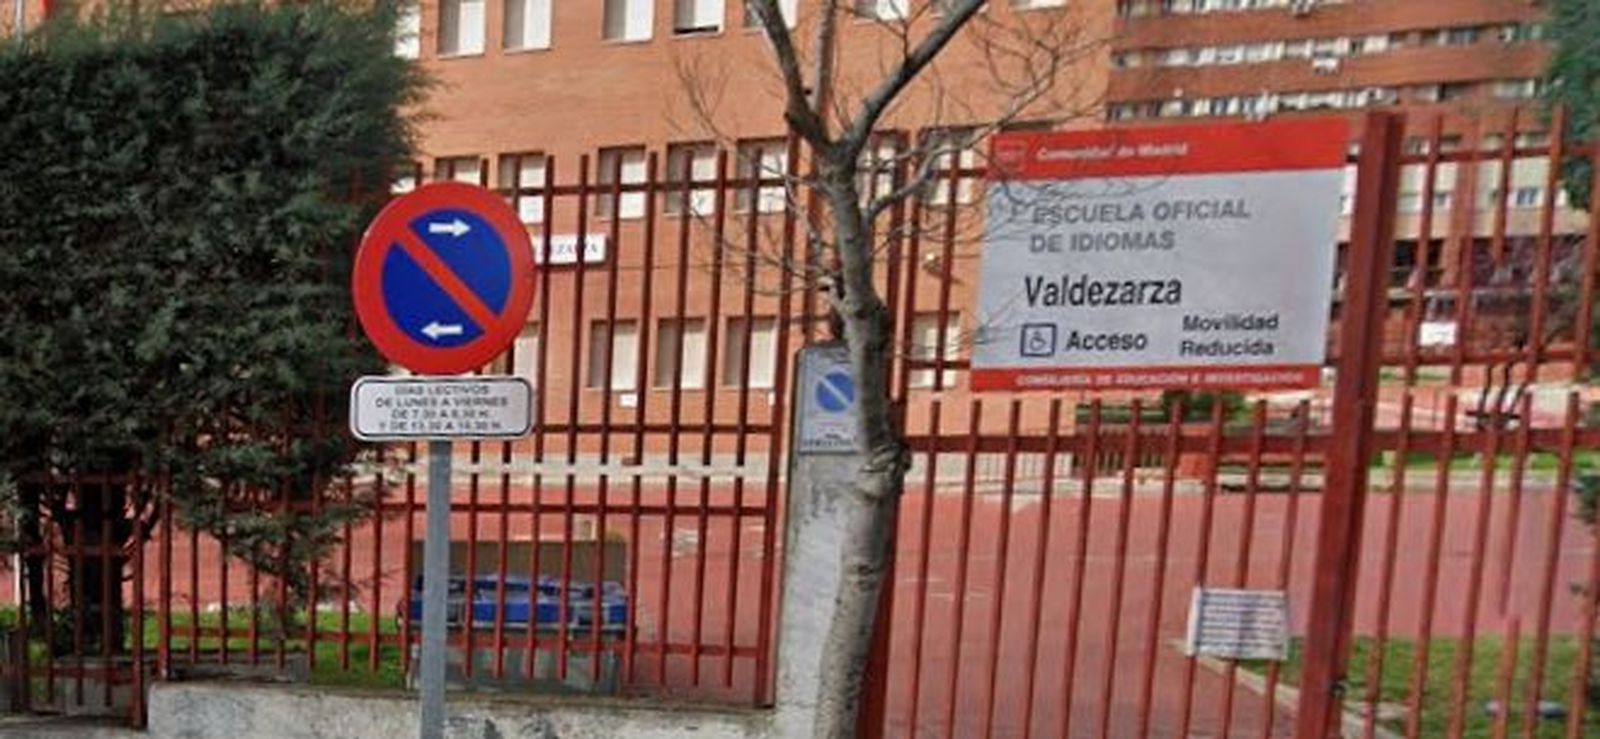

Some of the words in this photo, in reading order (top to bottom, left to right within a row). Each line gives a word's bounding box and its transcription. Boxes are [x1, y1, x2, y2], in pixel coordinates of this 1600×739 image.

[1032, 202, 1145, 226] ESCUELA
[1152, 198, 1251, 222] OFICIAL
[1029, 233, 1062, 254] DE
[1070, 230, 1176, 252] IDIOMAS
[1024, 275, 1182, 308] Valdezarza
[1065, 331, 1148, 352] Acceso
[1182, 314, 1280, 332] Movilidad
[1180, 340, 1275, 358] Reducida
